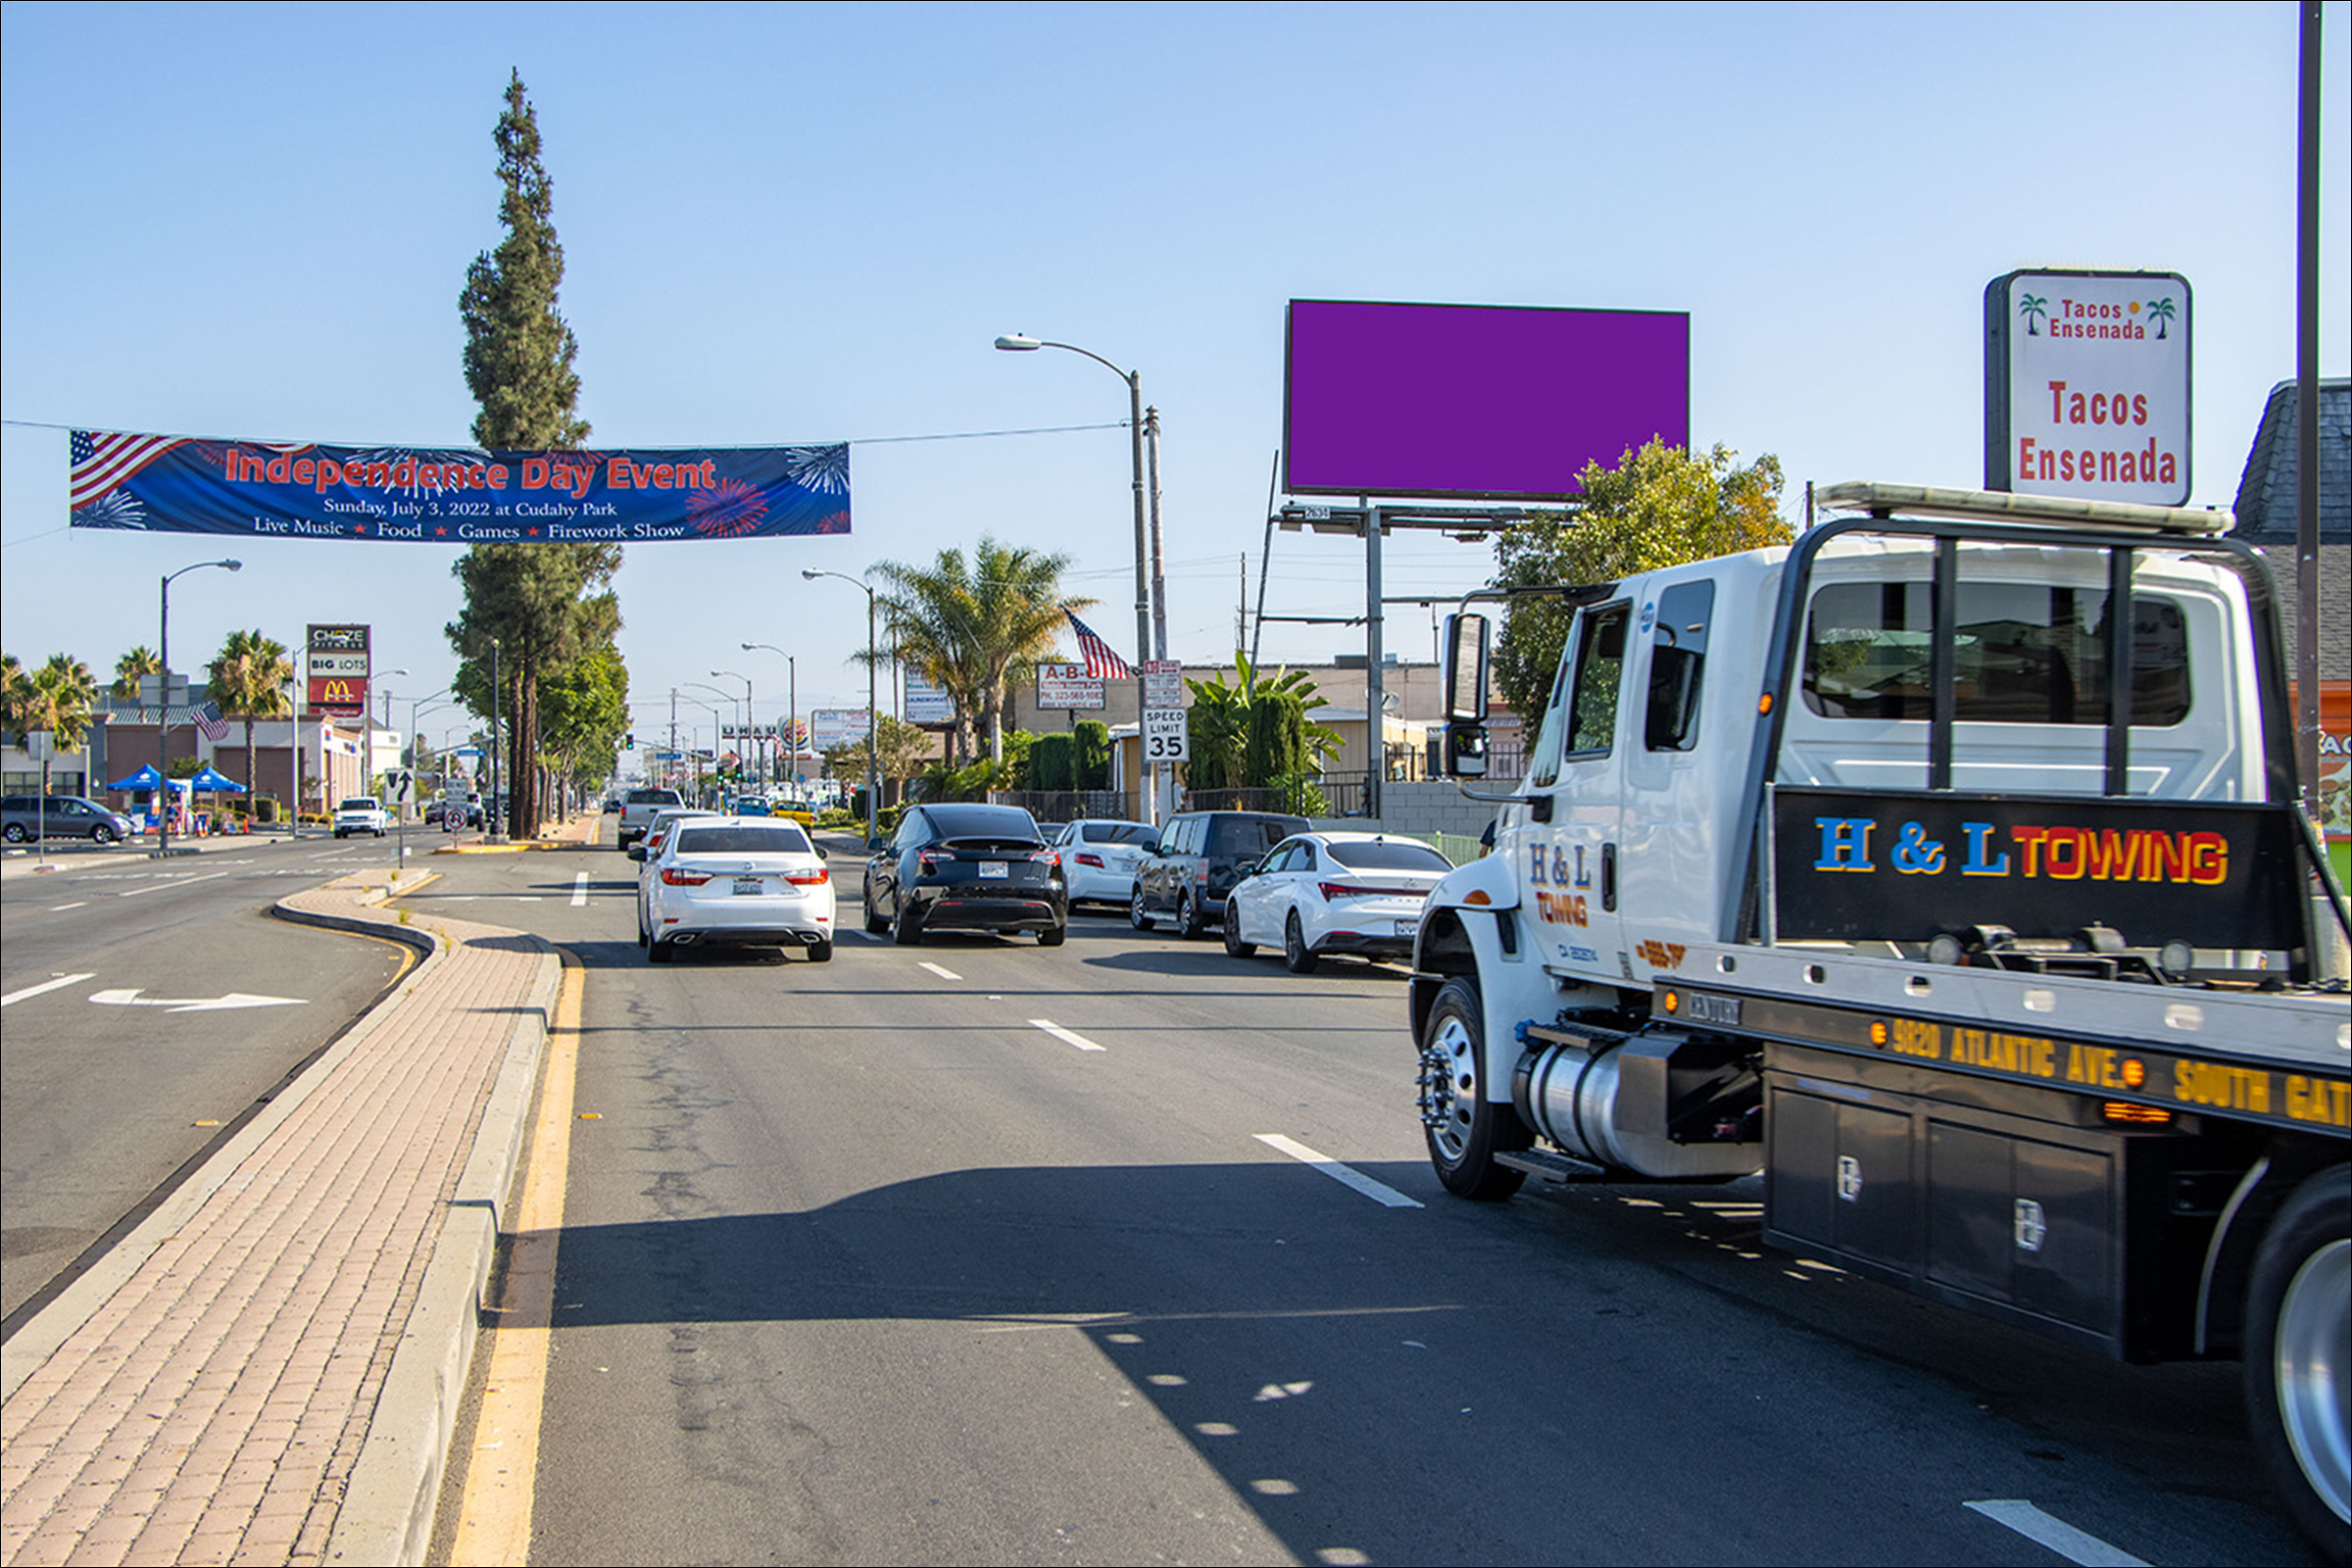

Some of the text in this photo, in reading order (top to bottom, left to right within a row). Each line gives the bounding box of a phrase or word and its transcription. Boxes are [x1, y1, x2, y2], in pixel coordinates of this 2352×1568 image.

[2062, 299, 2122, 318] Tacos
[2050, 318, 2145, 339] Ensenada
[2048, 380, 2148, 425] Tacos
[2019, 437, 2177, 483] Ensenada
[225, 448, 716, 499] Independence Day Event
[323, 498, 617, 520] Sunday, July 3, 2022 at Cudahy Park
[254, 516, 685, 539] Live Music Food Games Firework Show
[312, 659, 367, 670] BIG LOTS
[1146, 711, 1184, 722] SPEED
[722, 726, 776, 735] UHAU
[1150, 724, 1180, 733] LIMIT
[1150, 736, 1183, 757] 35
[1814, 817, 2229, 886] H & L TOWING
[1530, 843, 1592, 891] H & L
[1536, 891, 1590, 928] TOWING
[1892, 1018, 2351, 1127] 9820 ATLANTIC AVE. SOUTH GAT
